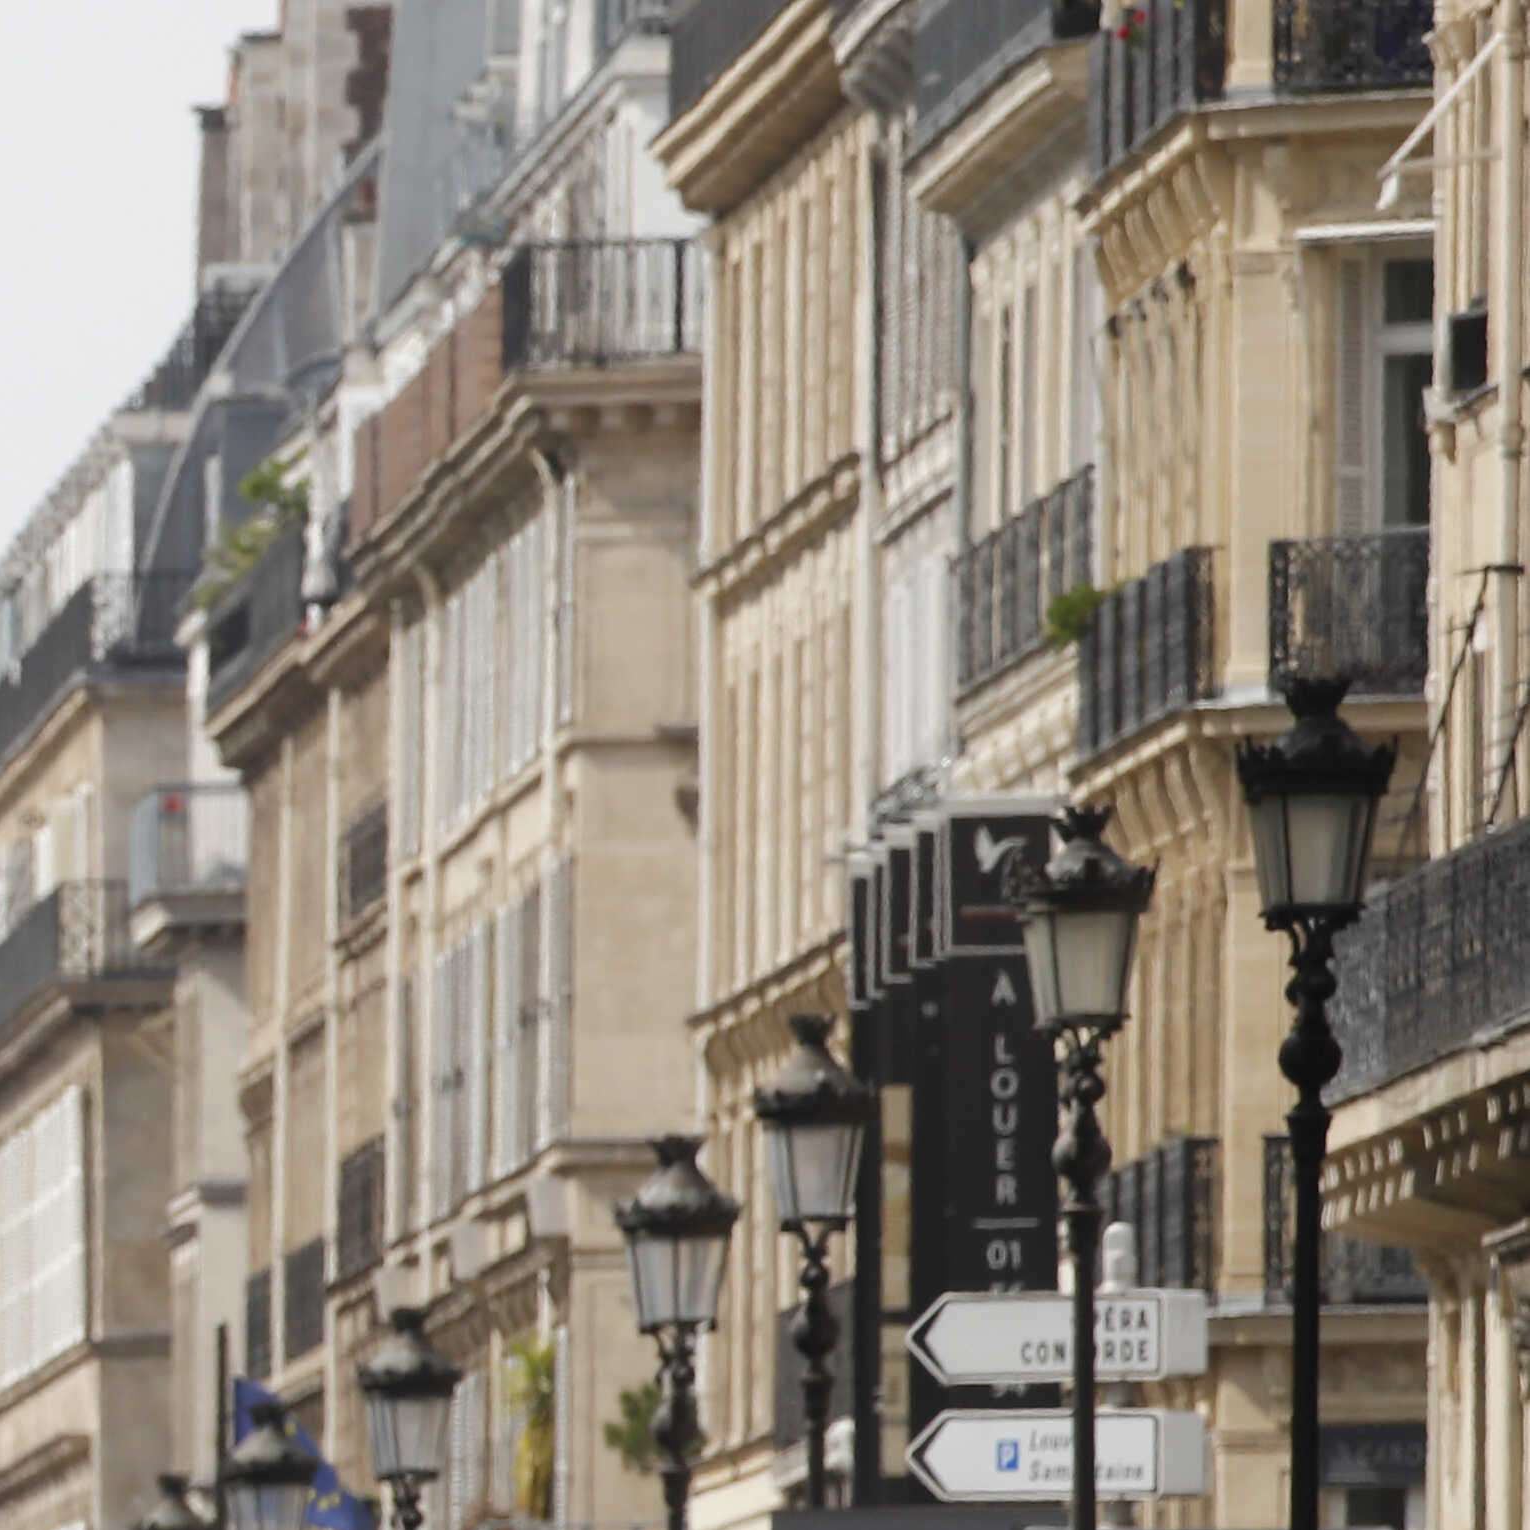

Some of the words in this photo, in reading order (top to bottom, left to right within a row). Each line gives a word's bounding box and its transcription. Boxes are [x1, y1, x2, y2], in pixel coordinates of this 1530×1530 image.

[990, 1034, 1019, 1204] LOUER
[987, 1240, 1021, 1270] 01
[1092, 1305, 1149, 1331] ÉRA
[1021, 1341, 1149, 1364] CONRDE
[1029, 1429, 1073, 1451] Louv
